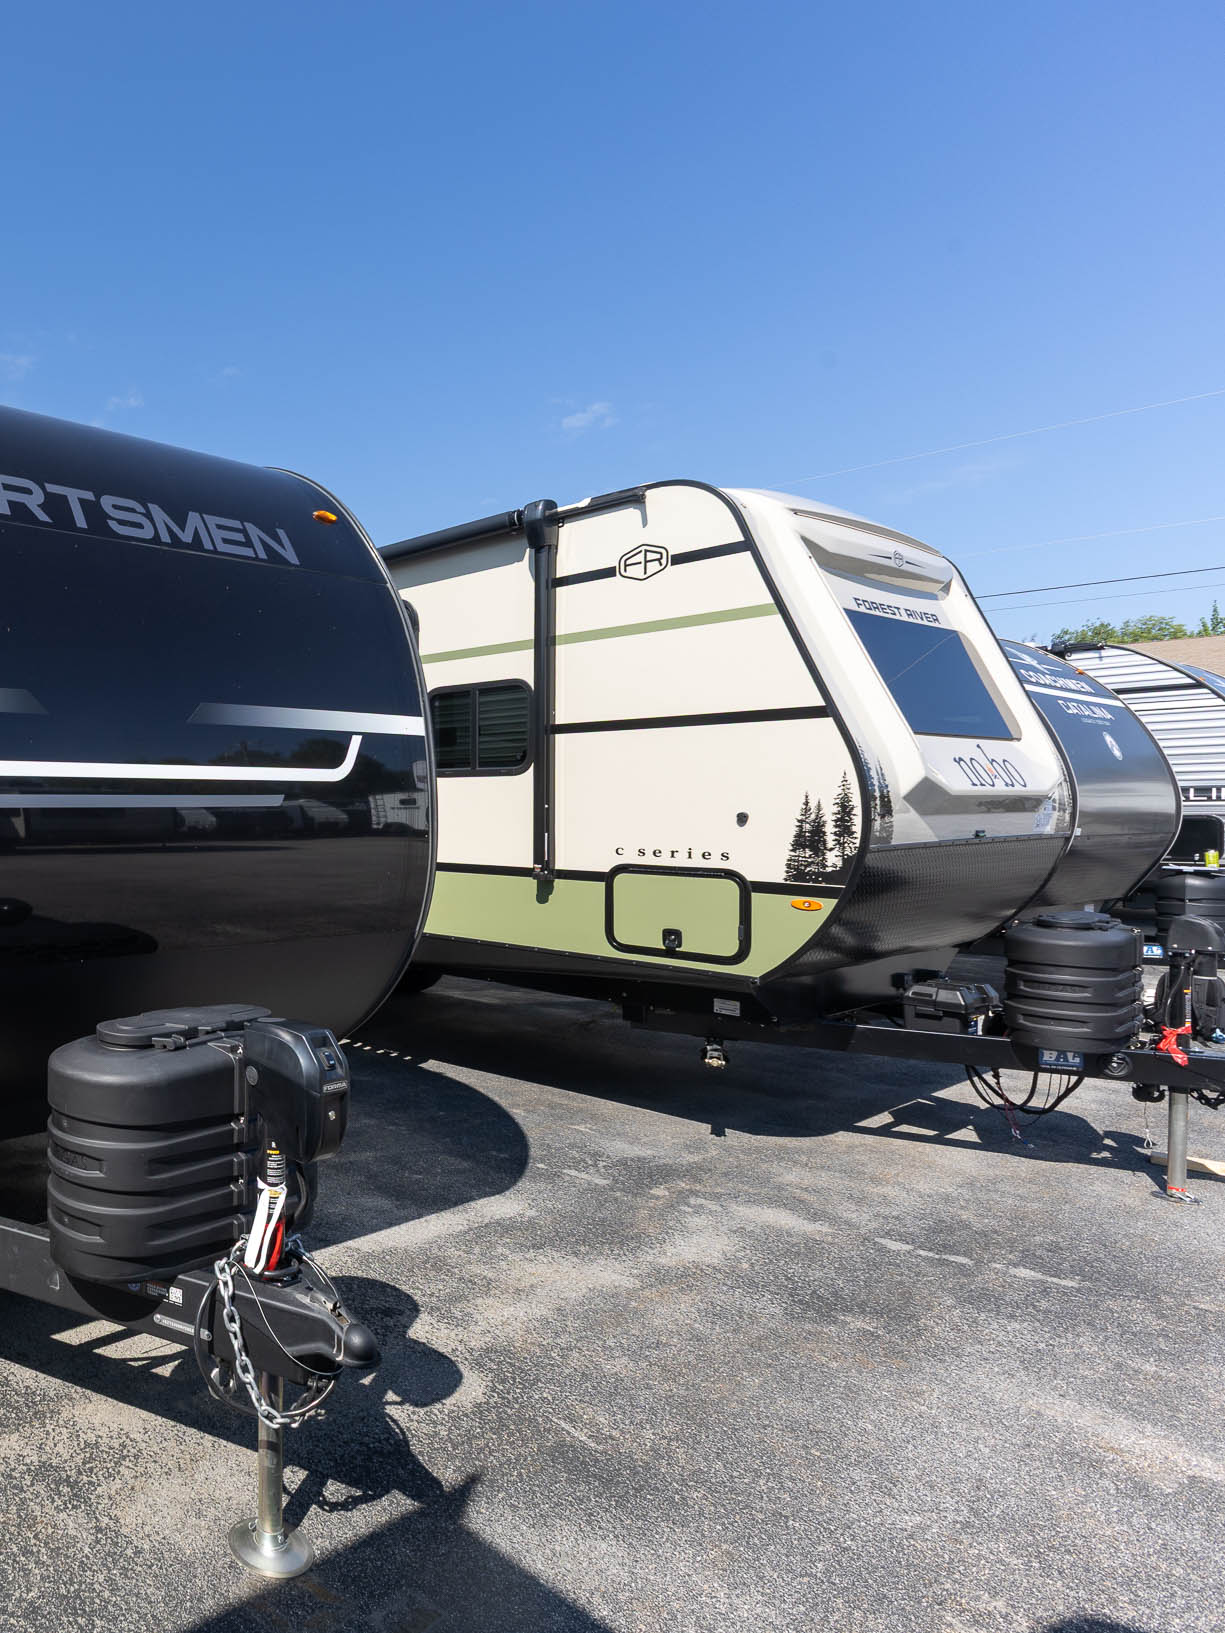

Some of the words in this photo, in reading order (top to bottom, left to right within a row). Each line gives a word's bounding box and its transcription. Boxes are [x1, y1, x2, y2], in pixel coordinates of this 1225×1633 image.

[853, 597, 903, 617] FOREST
[903, 608, 941, 625] RIVER
[1019, 669, 1095, 693] COACHMEN
[1057, 700, 1115, 720] CATALINA
[615, 847, 625, 856] c
[637, 847, 730, 861] series
